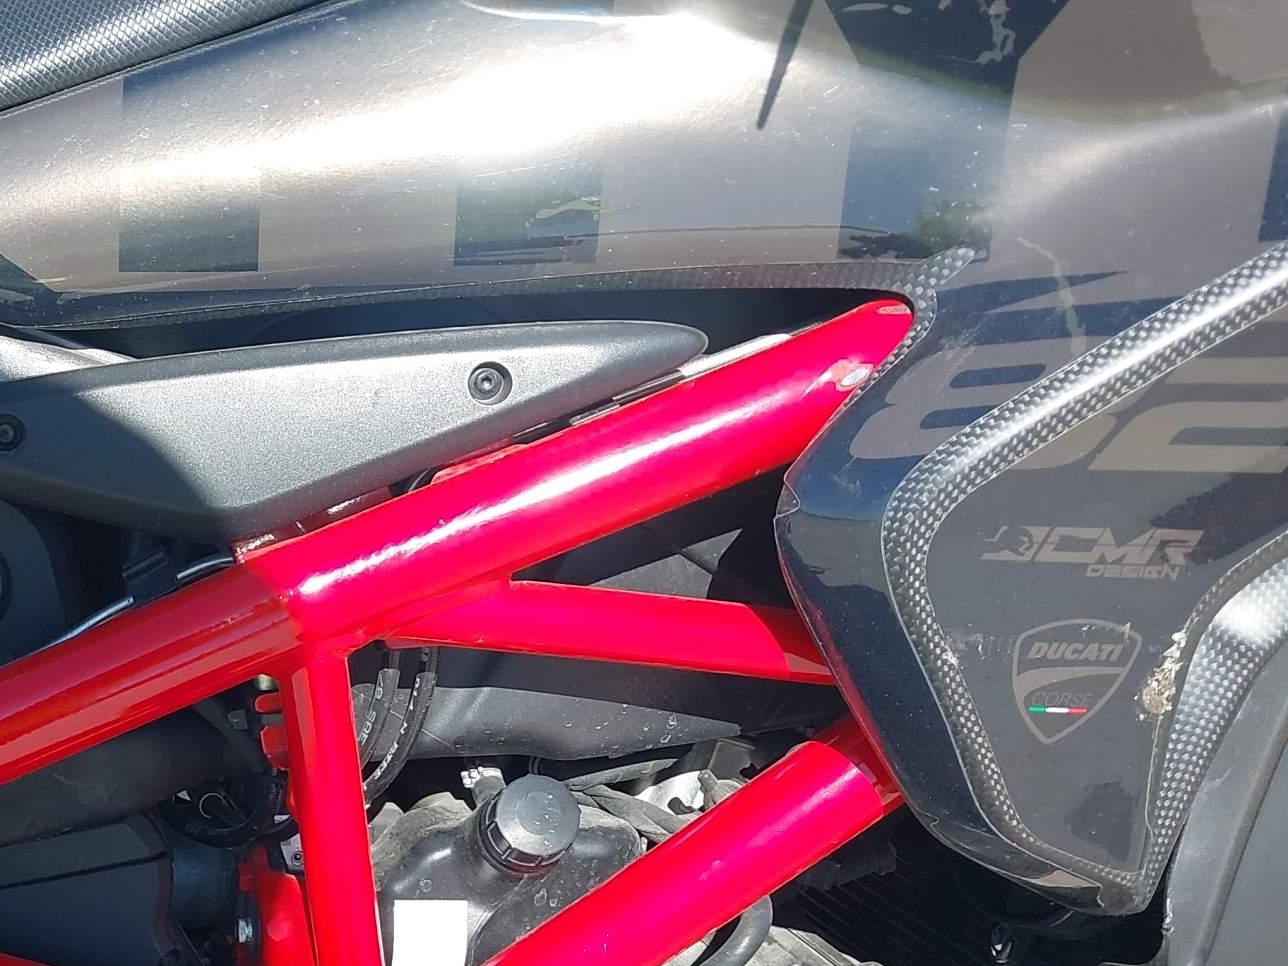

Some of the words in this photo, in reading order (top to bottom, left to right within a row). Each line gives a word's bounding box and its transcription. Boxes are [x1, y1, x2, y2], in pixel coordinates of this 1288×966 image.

[1086, 564, 1180, 582] DESIGN
[1028, 641, 1124, 662] DUCATI
[1031, 691, 1096, 707] CORSE
